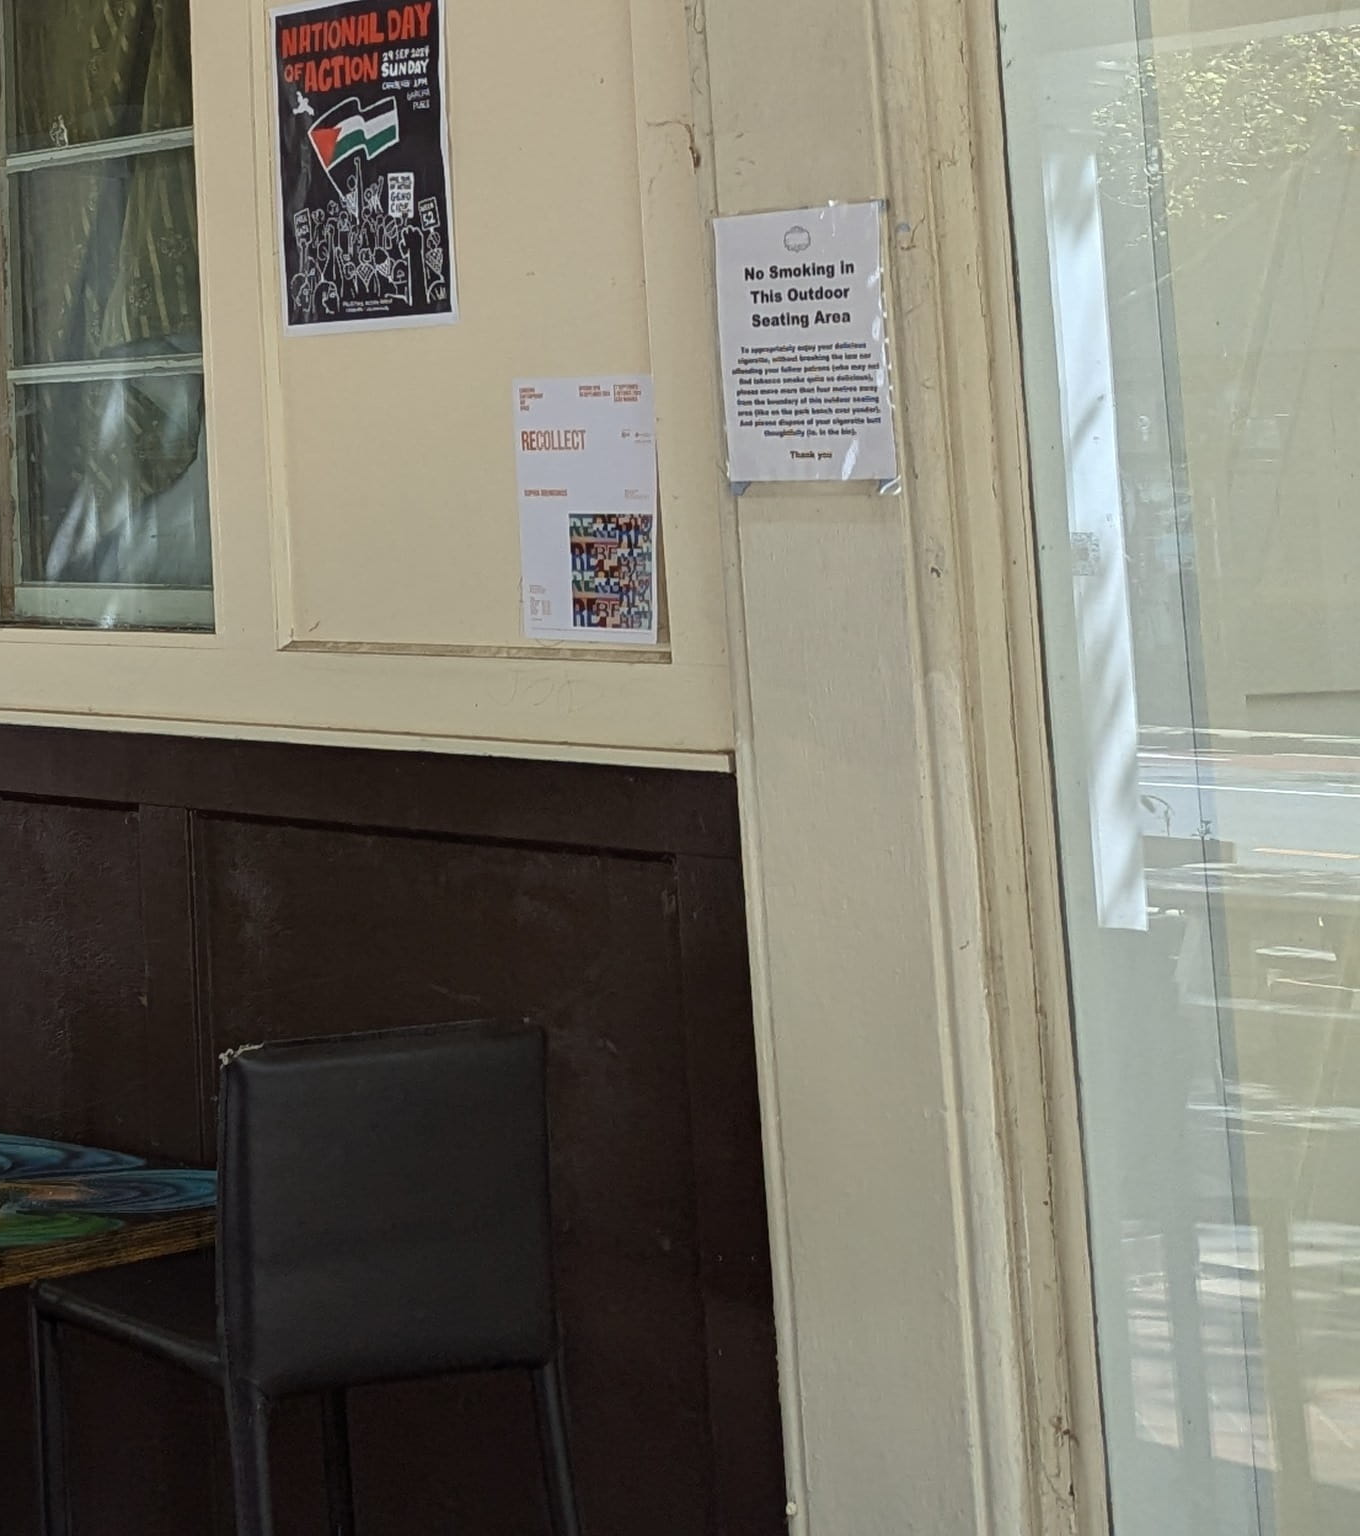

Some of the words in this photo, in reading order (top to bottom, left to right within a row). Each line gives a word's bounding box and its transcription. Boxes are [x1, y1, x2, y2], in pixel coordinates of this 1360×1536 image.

[282, 12, 384, 59] NATIONAL
[387, 1, 431, 41] DAY
[395, 47, 410, 61] SEP
[284, 62, 304, 82] OF
[304, 52, 379, 93] ACTION
[381, 58, 429, 77] SUNDAY
[744, 266, 765, 282] No
[769, 262, 835, 280] Smoking
[839, 259, 855, 275] in
[750, 289, 783, 304] This
[787, 286, 850, 302] Outdoor
[752, 312, 810, 329] Seating
[814, 309, 851, 325] Area
[520, 429, 586, 453] RECOLLECT
[789, 450, 815, 459] Thank
[817, 450, 833, 461] you
